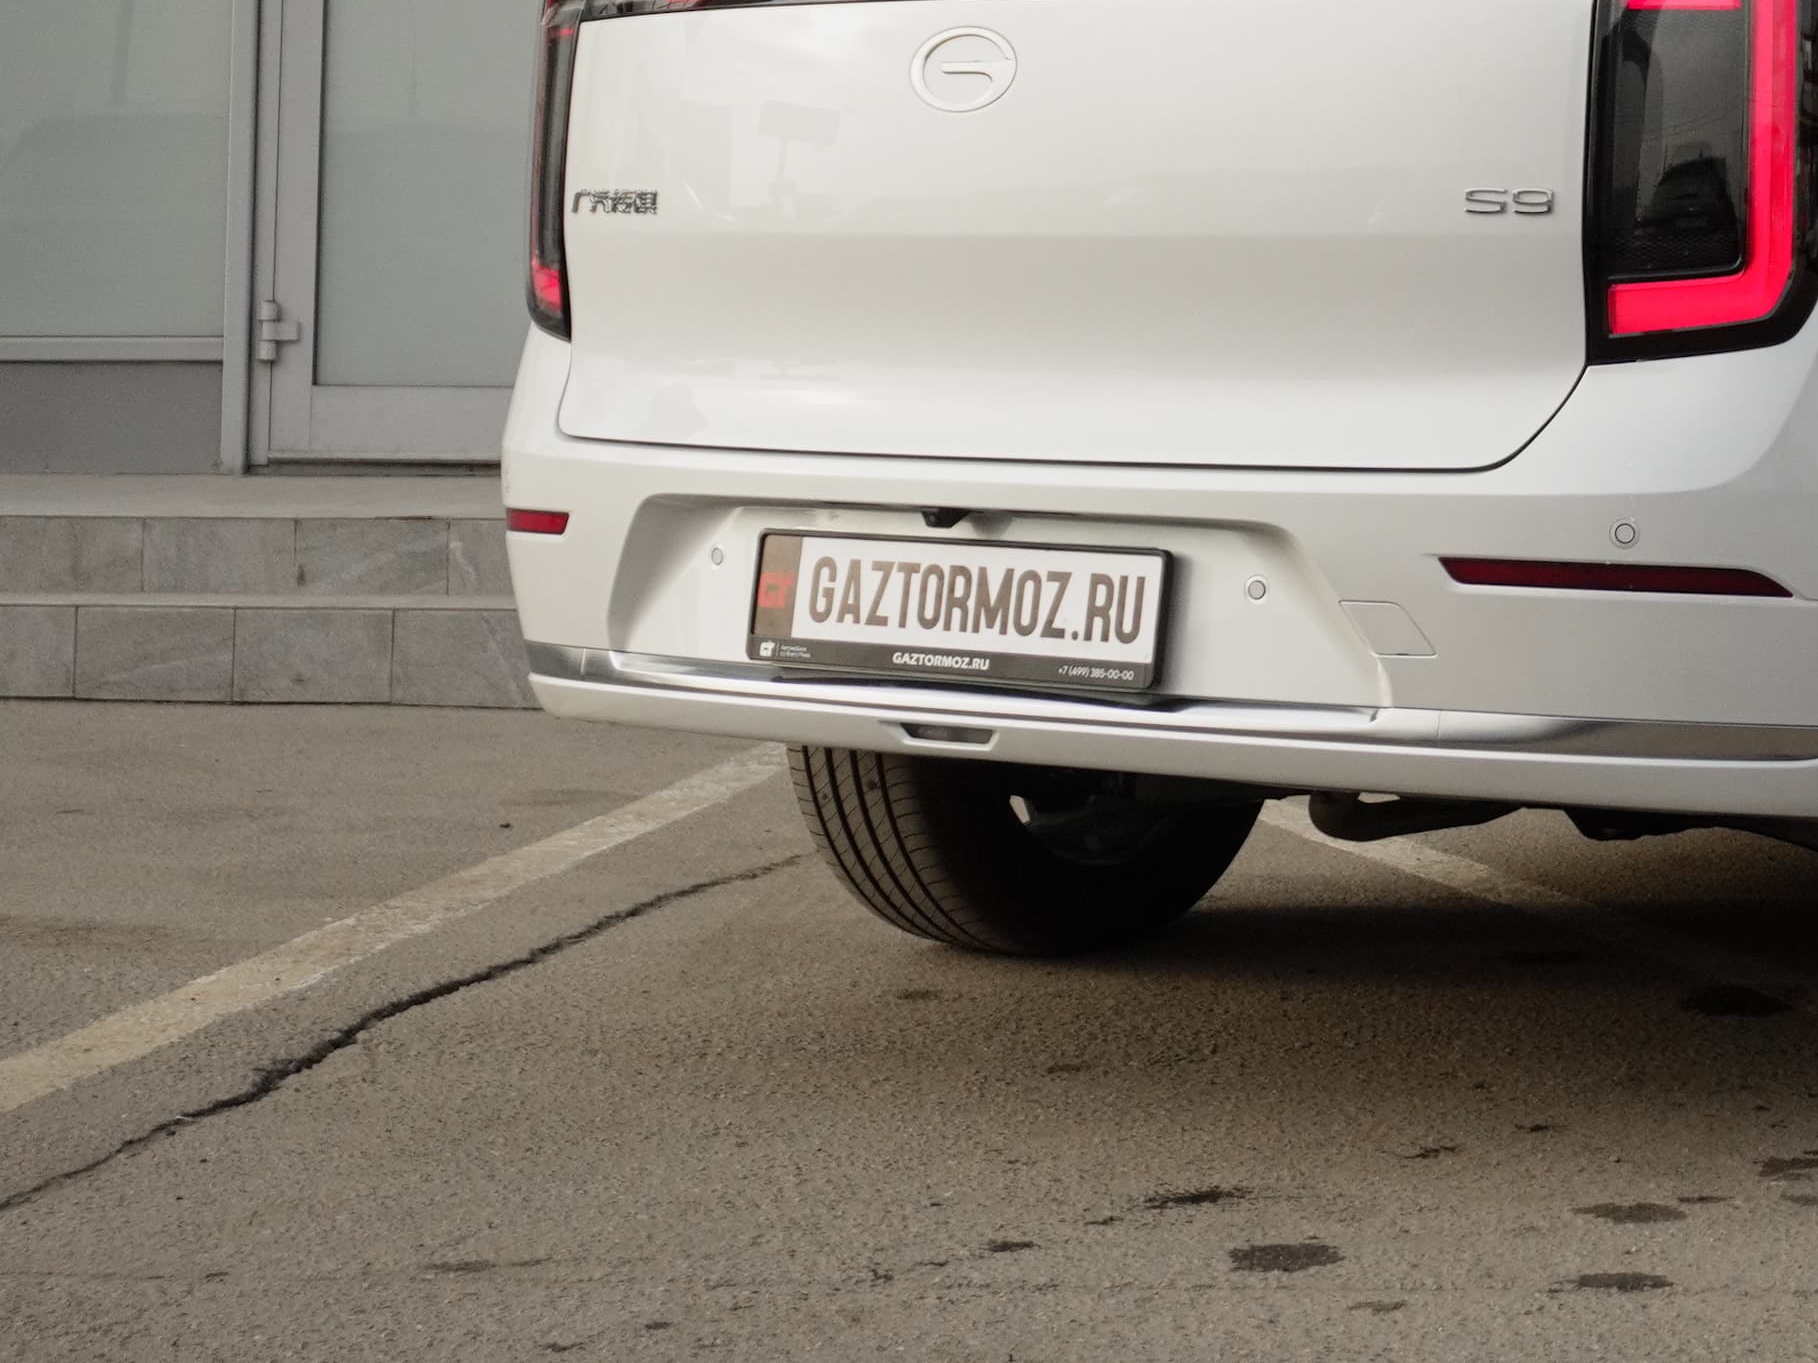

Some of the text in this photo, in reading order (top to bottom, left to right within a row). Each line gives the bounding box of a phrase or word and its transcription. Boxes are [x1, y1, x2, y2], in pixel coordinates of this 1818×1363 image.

[1463, 187, 1555, 215] S9
[808, 555, 1146, 645] GAZTORMOZ.RU
[892, 651, 990, 671] GAZTORMOZ.RU
